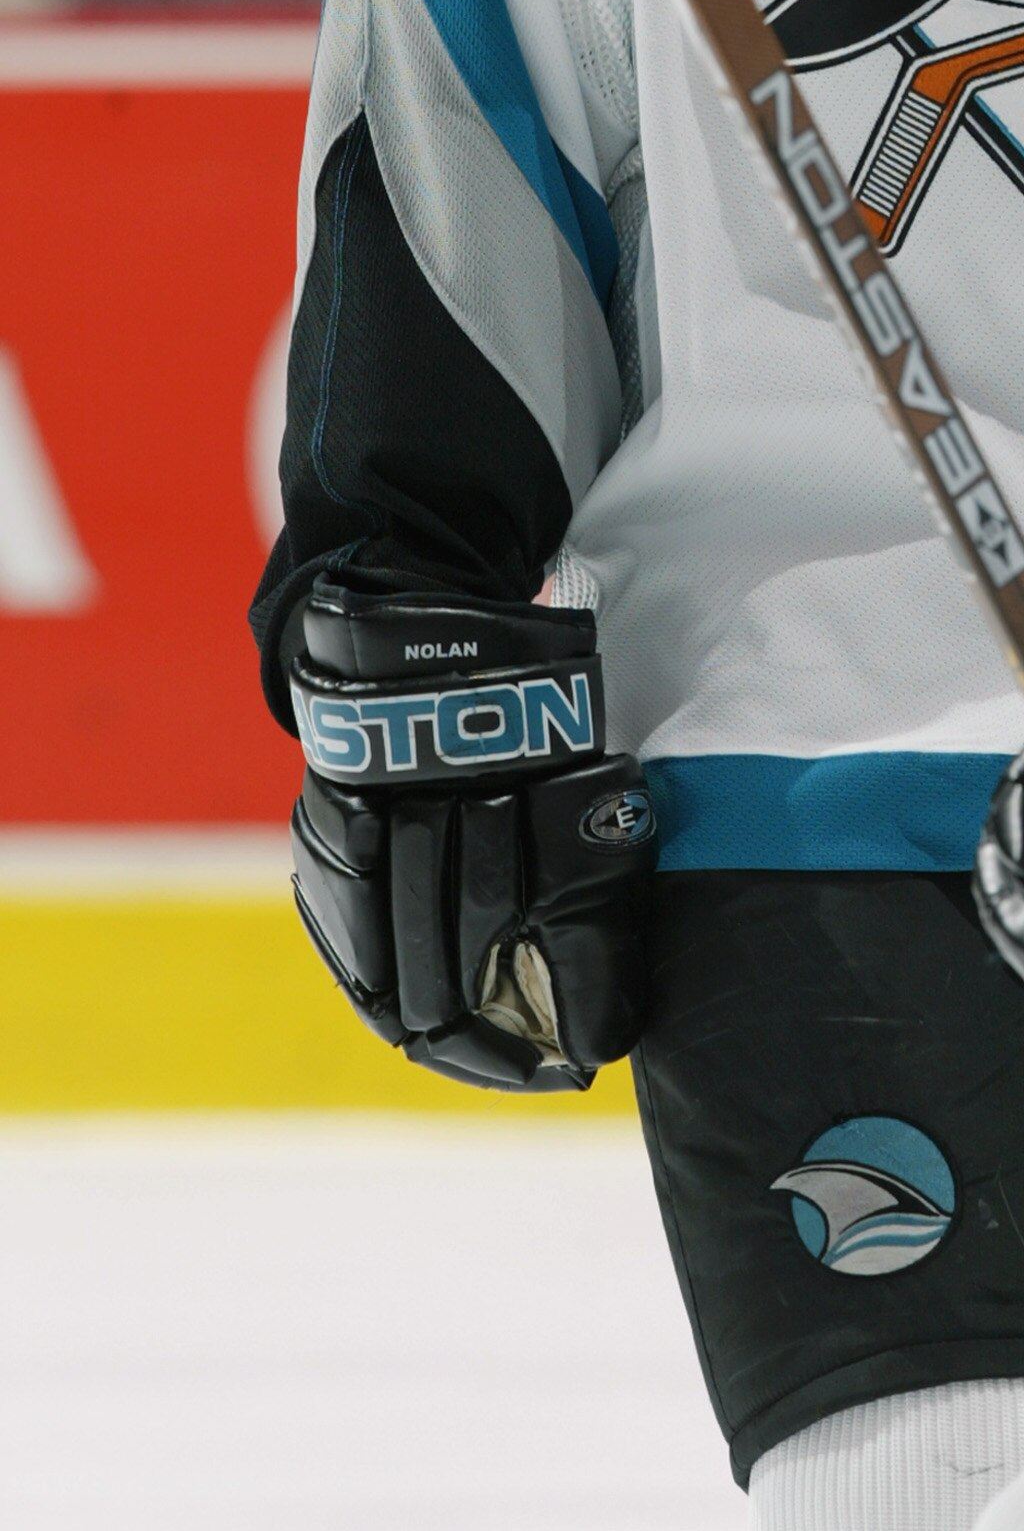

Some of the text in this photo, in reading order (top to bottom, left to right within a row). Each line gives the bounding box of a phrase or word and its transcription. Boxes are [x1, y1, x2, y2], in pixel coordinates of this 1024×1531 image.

[750, 70, 988, 498] EASTON
[404, 641, 478, 661] NOLAN
[616, 805, 636, 829] E
